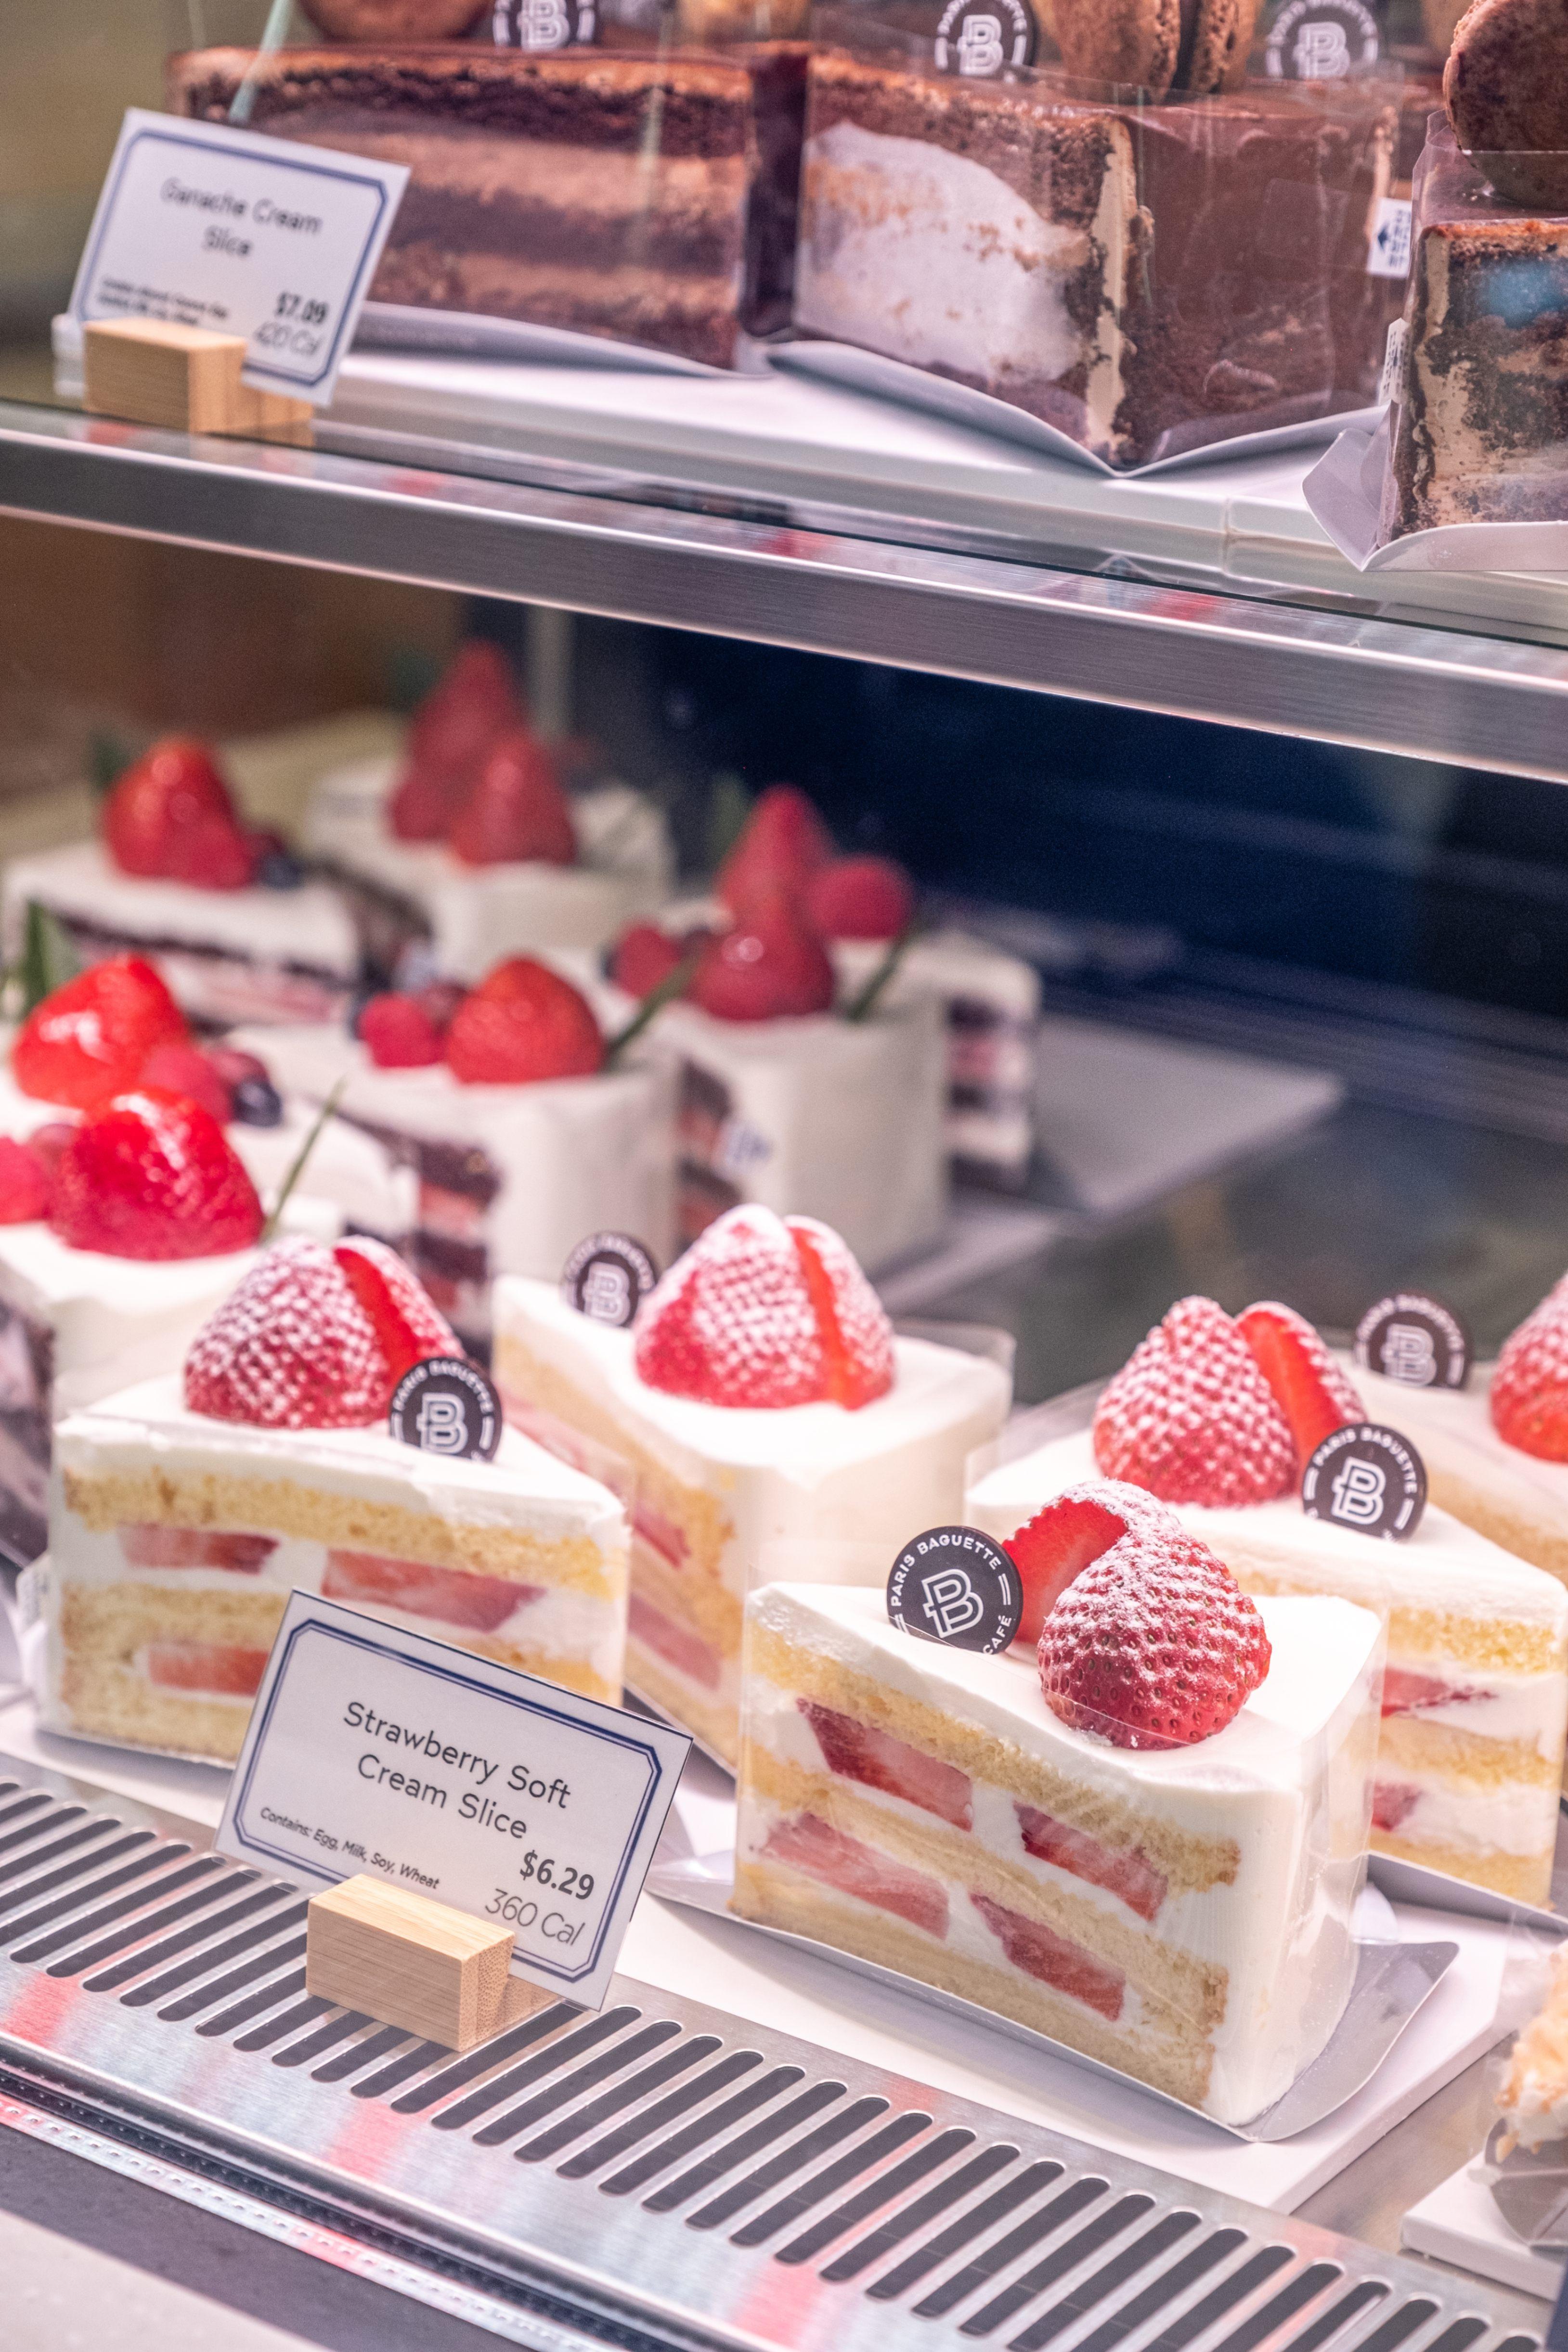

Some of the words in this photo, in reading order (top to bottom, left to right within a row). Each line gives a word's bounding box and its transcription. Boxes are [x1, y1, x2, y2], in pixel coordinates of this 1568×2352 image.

[161, 177, 247, 218] Ganache
[253, 198, 323, 235] Cream
[203, 225, 253, 257] Slice
[1312, 1429, 1356, 1466] PARIS
[1361, 1427, 1417, 1494] BAGUETTE
[891, 1554, 915, 1606] PARIS
[917, 1535, 1001, 1570] BAGUETTE
[983, 1615, 1011, 1654] CAFÉ
[344, 1702, 499, 1784] Strawberry
[508, 1765, 570, 1809] Soft
[358, 1754, 447, 1809] Cream
[458, 1793, 526, 1838] Slice
[260, 1807, 312, 1837] Contains:
[313, 1829, 338, 1851] Egg,
[343, 1841, 367, 1862] Milk,
[371, 1853, 395, 1874] Soy,
[400, 1863, 441, 1889] Wheat
[520, 1849, 594, 1900] $6.29
[485, 1888, 538, 1926] 360
[541, 1913, 585, 1946] Cal
